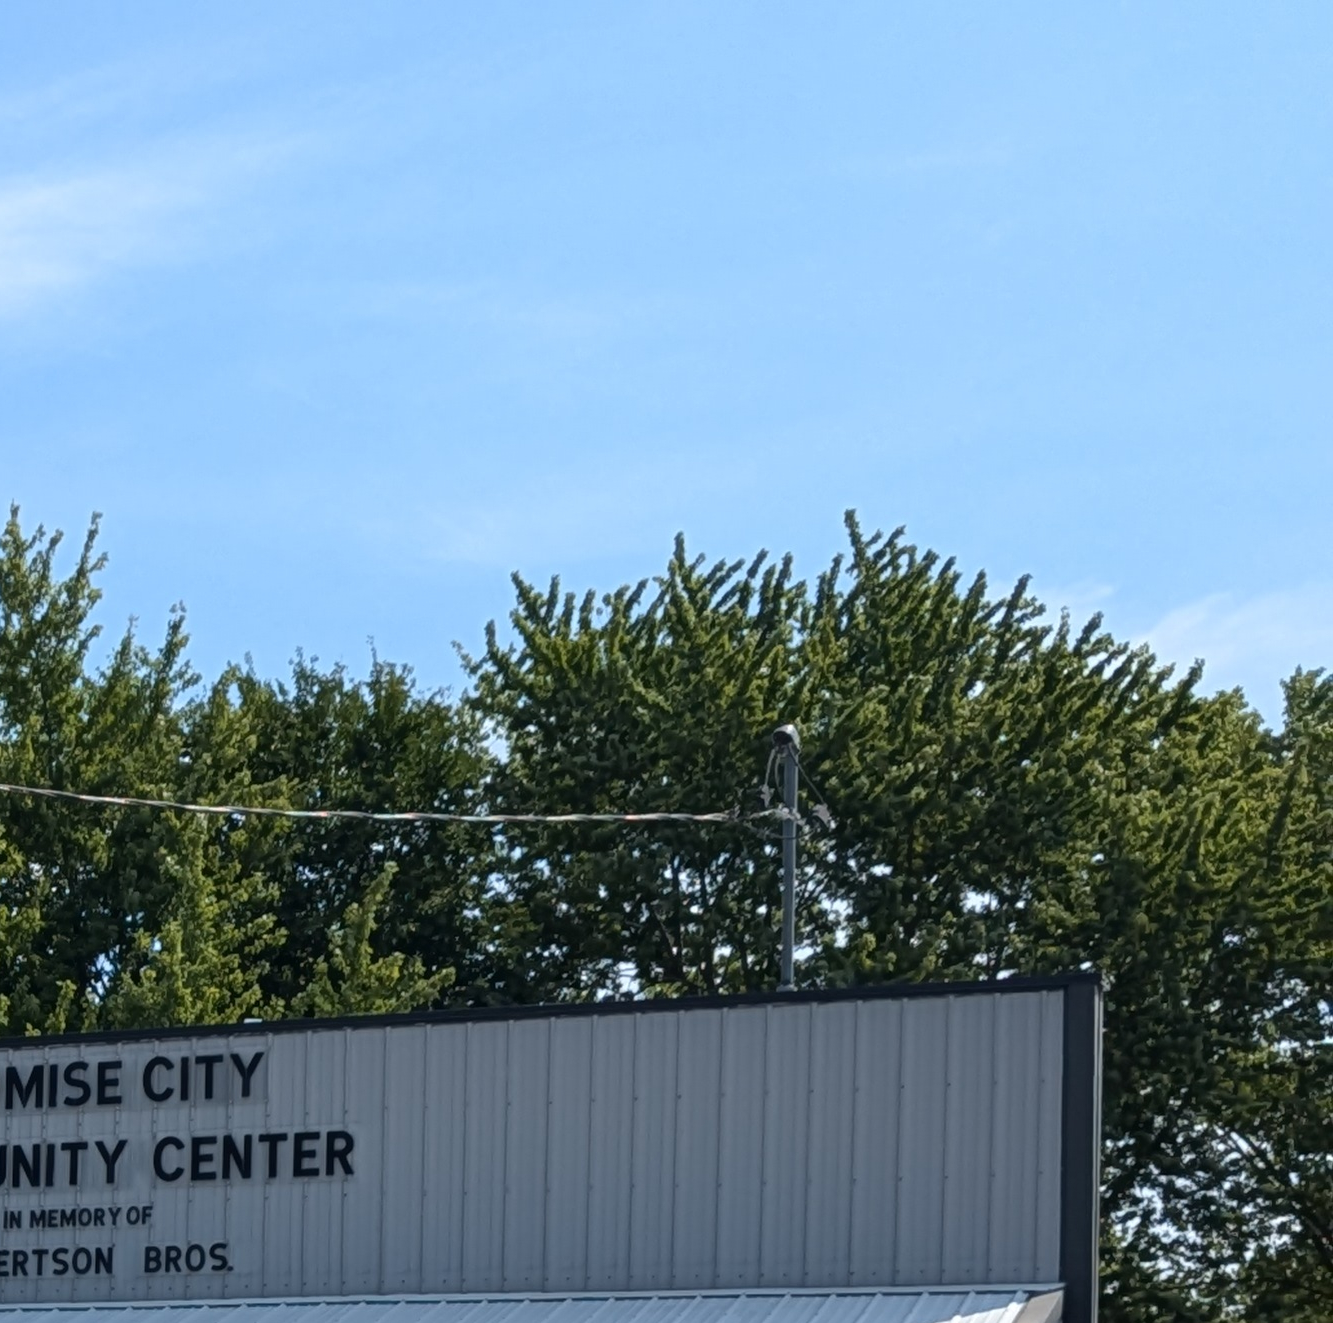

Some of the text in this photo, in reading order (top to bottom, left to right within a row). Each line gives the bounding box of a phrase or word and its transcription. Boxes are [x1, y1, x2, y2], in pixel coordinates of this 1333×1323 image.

[142, 1052, 264, 1101] CITY
[152, 1130, 355, 1182] CENTER
[3, 1205, 153, 1229] IN MEMORY OF
[144, 1242, 234, 1273] BROS.
